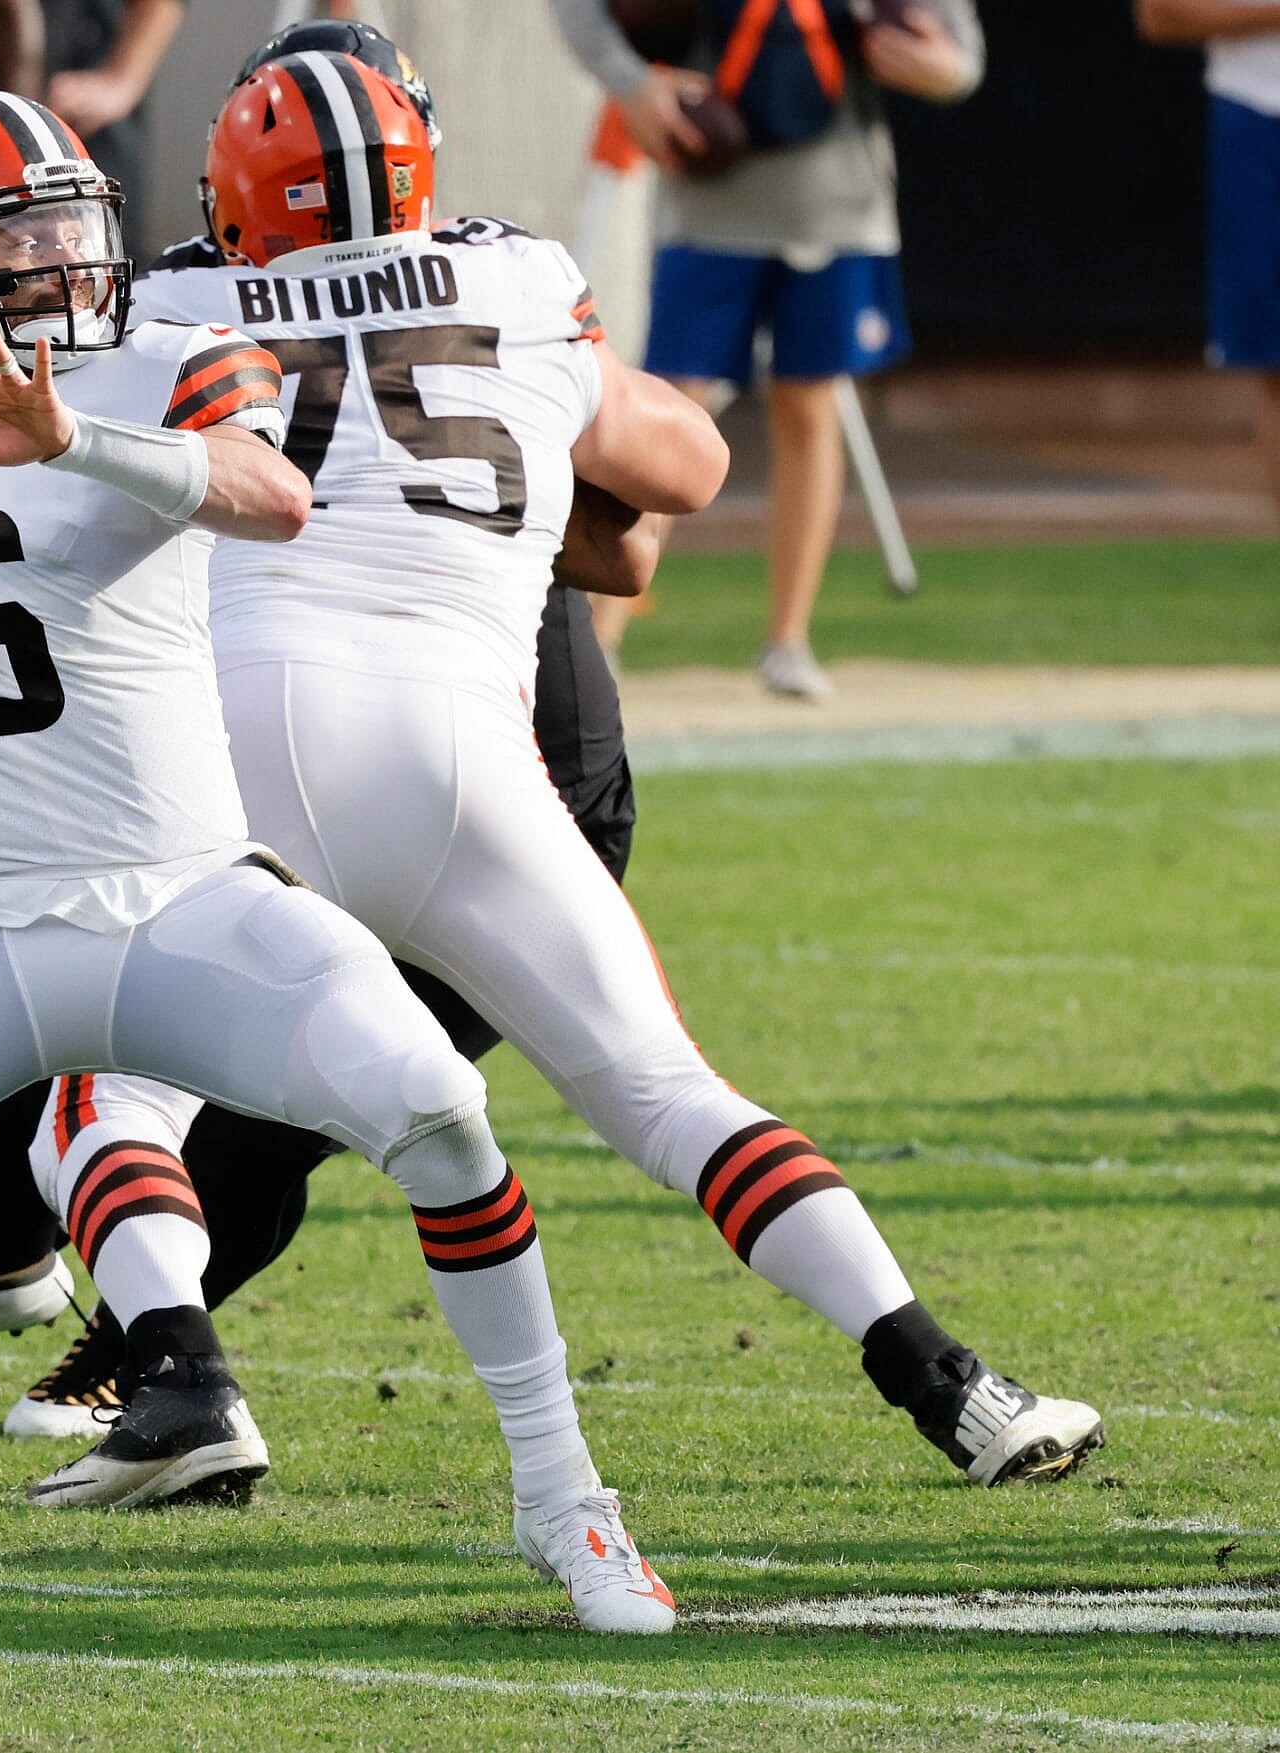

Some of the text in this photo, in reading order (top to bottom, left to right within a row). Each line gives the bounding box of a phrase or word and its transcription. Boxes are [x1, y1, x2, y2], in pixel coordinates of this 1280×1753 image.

[394, 201, 406, 228] 5
[325, 254, 334, 263] IT
[336, 252, 363, 262] TAKES
[366, 247, 381, 258] ALL
[256, 324, 527, 538] 75
[955, 1373, 1024, 1456] NIKE
